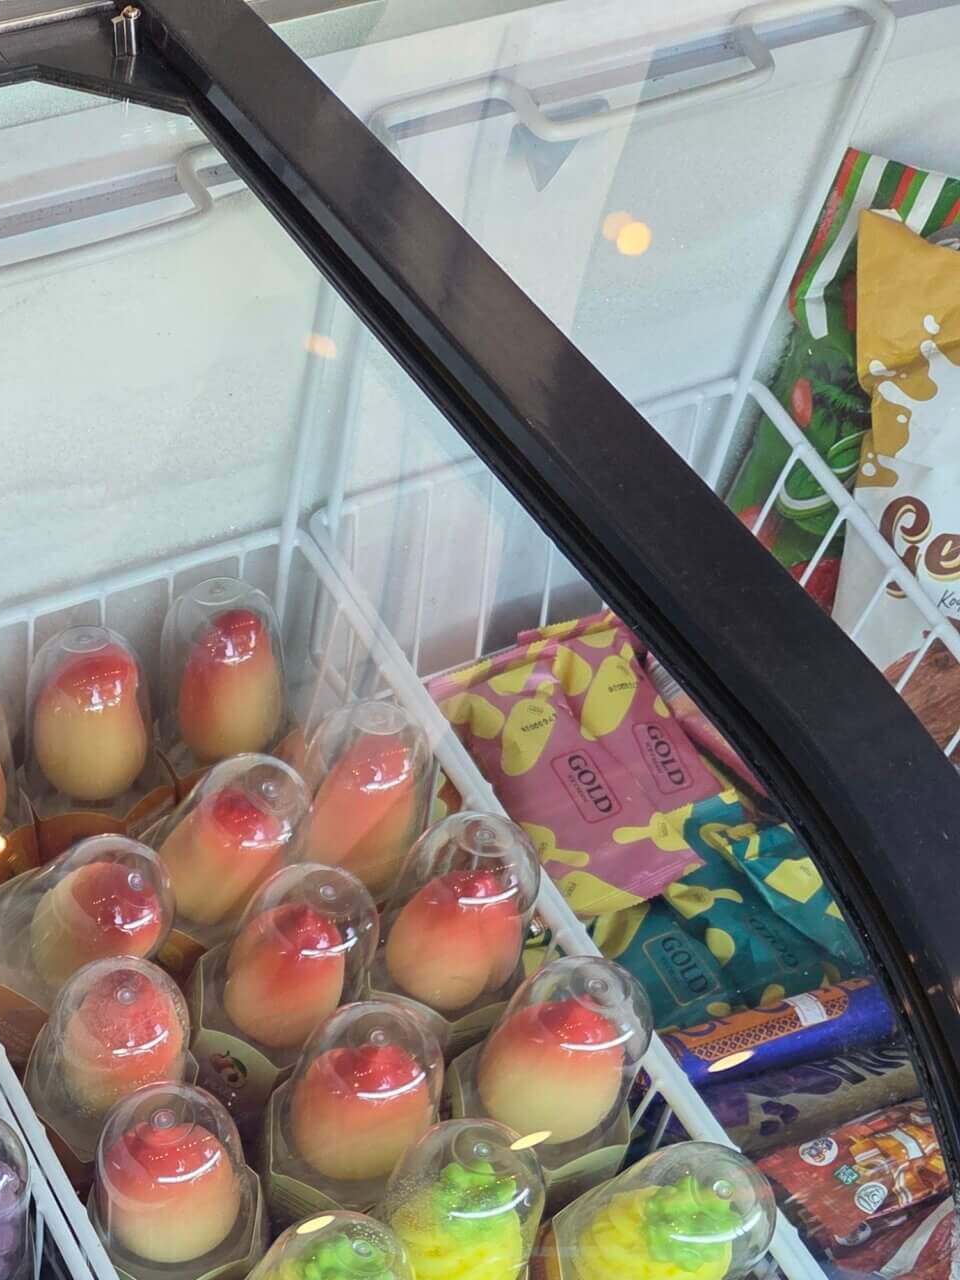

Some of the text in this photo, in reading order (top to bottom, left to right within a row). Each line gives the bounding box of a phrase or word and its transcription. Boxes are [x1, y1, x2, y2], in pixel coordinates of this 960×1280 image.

[568, 755, 613, 813] GOLD
[648, 725, 686, 786] GOLD
[661, 936, 709, 994] GOLD
